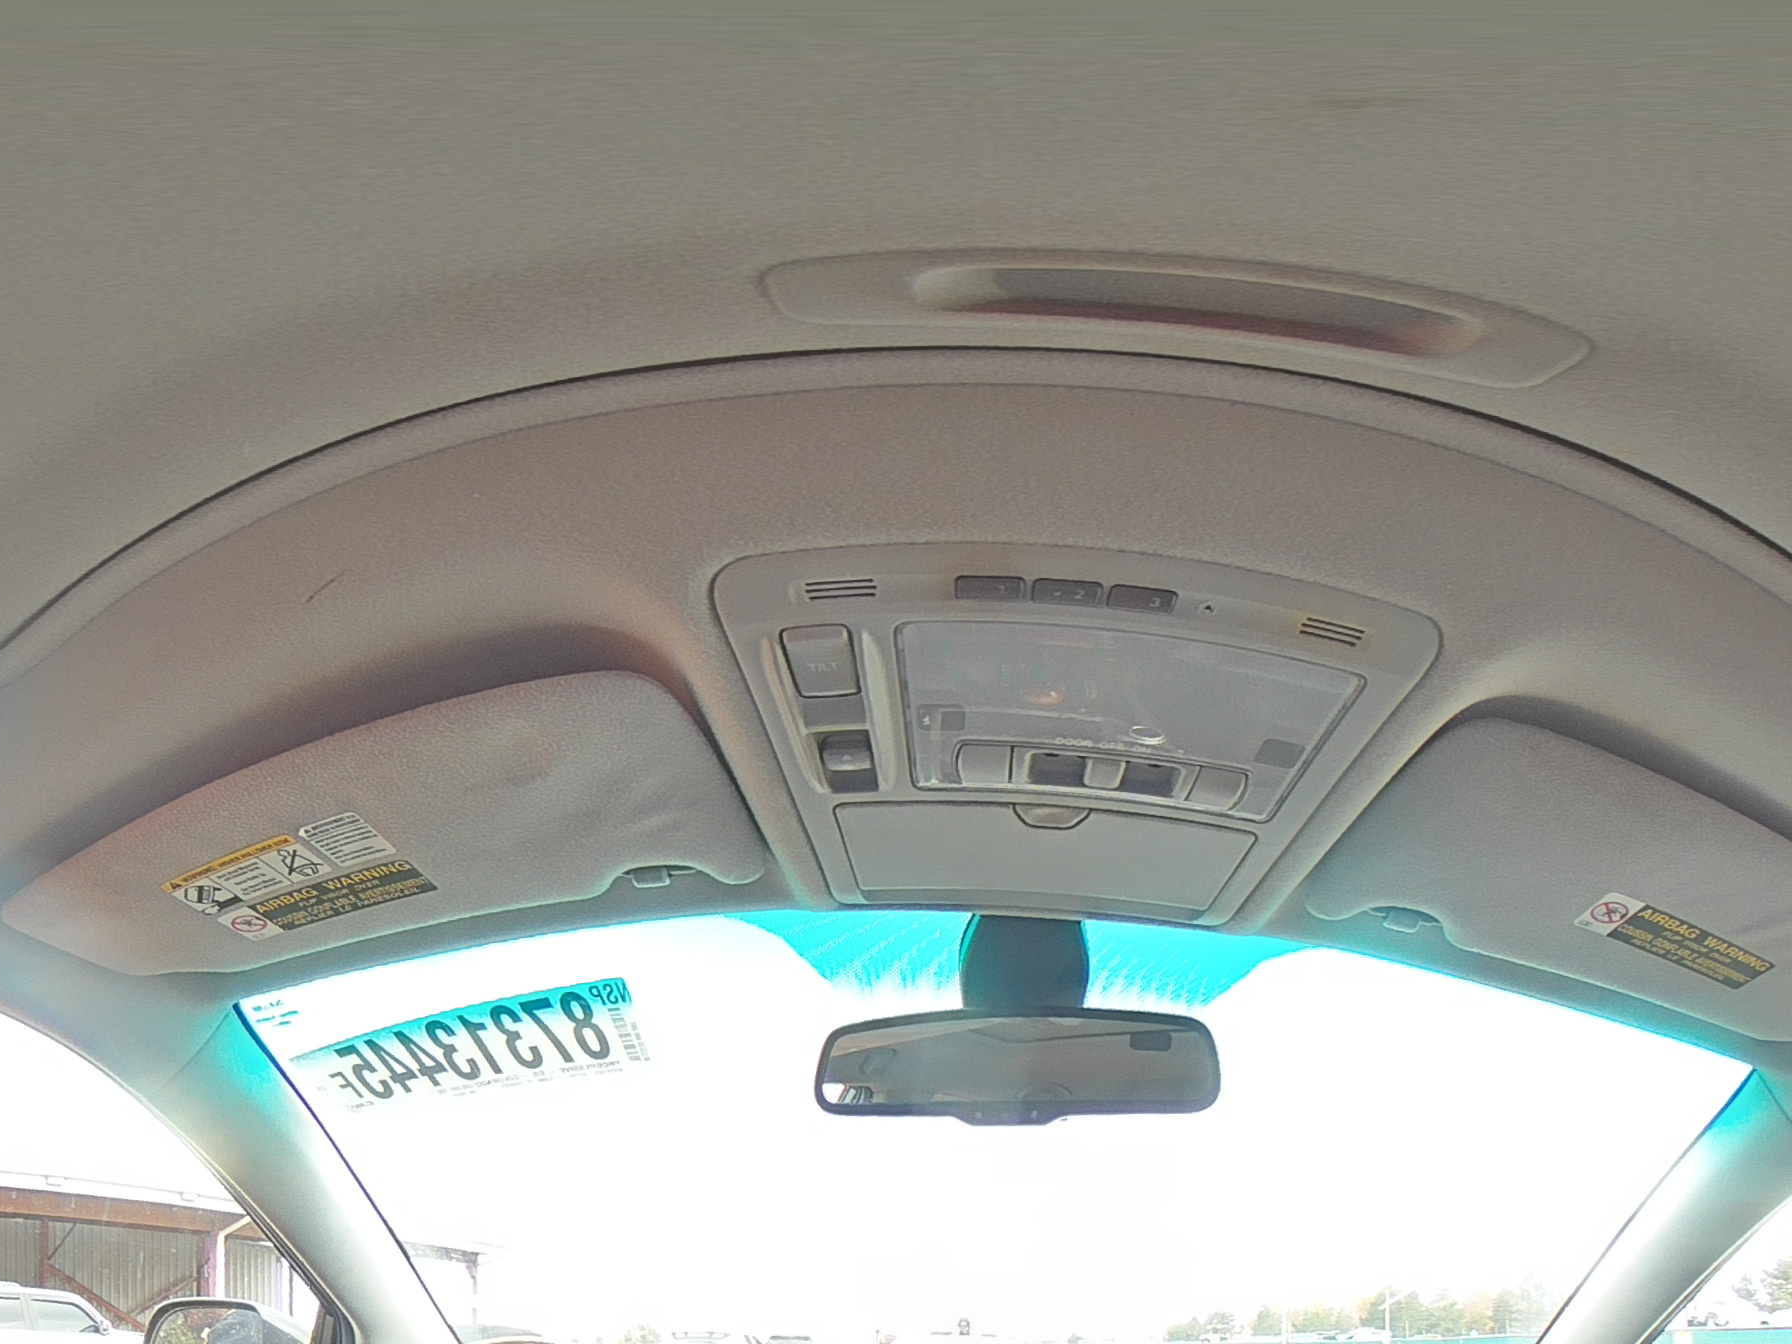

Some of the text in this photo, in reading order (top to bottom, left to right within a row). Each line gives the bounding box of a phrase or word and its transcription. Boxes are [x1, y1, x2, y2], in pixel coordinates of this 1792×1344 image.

[1074, 589, 1085, 600] 2
[1149, 597, 1161, 608] 3
[808, 660, 839, 673] TILT
[1054, 736, 1093, 748] DOOR
[255, 861, 413, 914] AIRBAG WARNING
[1637, 909, 1770, 972] AIRBAG WARNING
